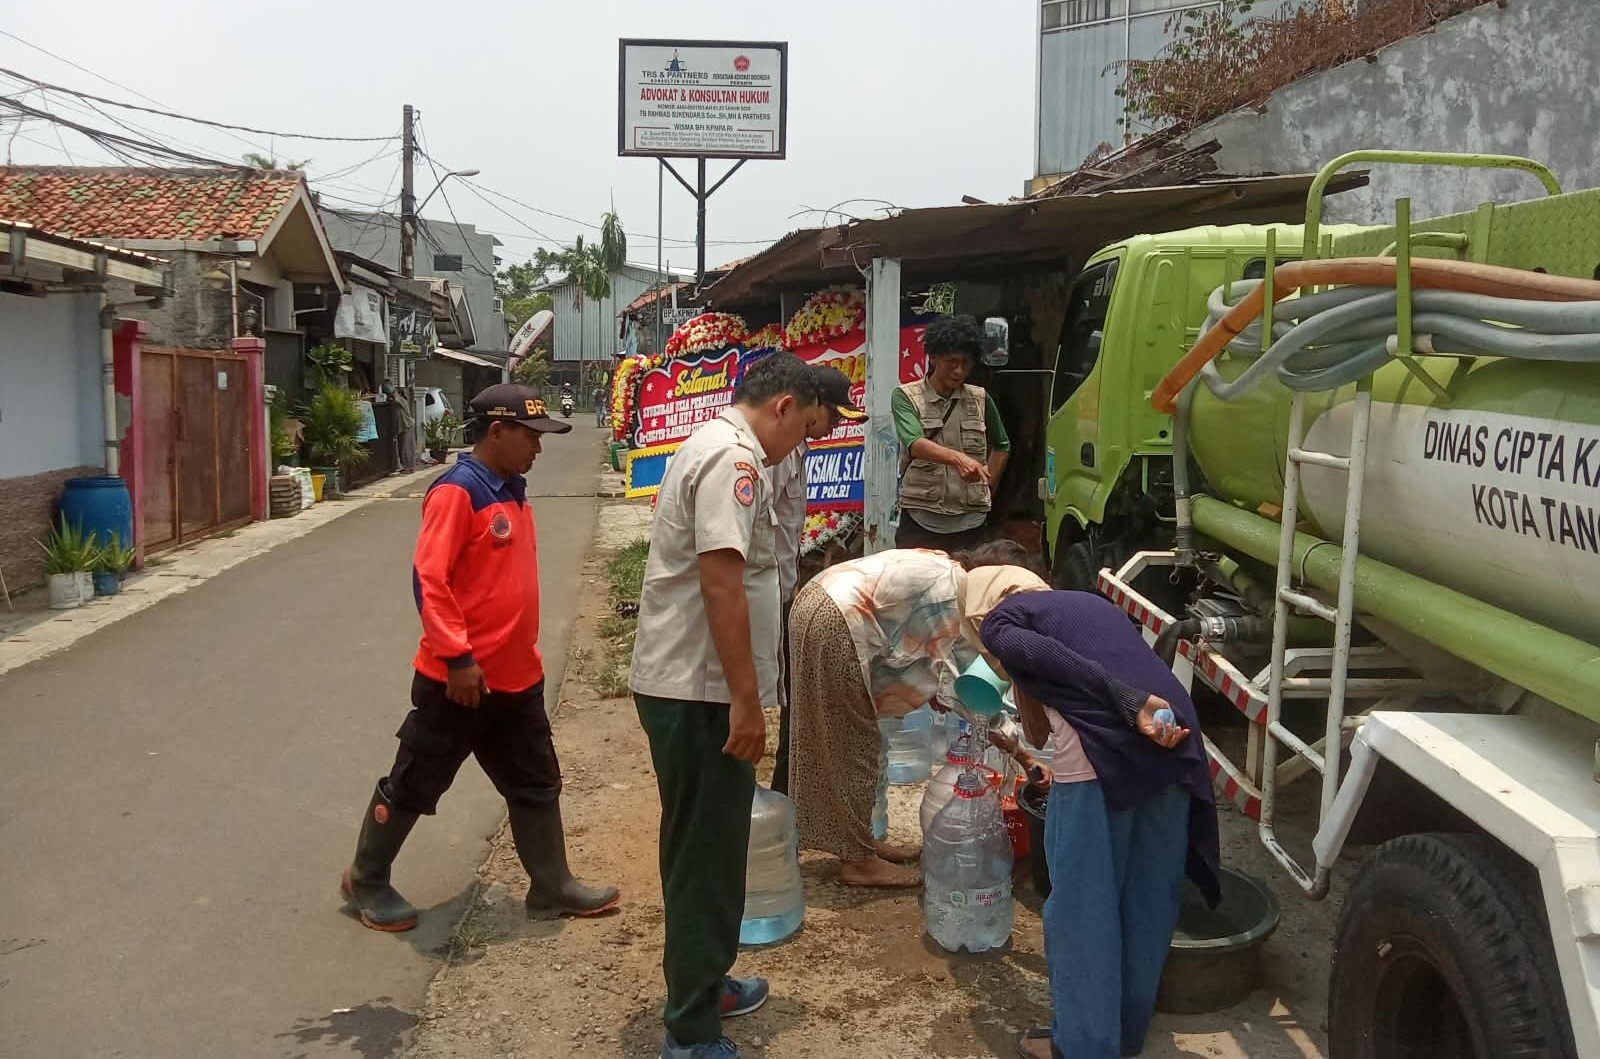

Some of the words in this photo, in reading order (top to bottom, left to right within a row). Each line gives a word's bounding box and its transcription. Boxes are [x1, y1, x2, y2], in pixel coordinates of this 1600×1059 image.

[642, 70, 657, 78] TRS
[667, 71, 709, 80] PARTNERS
[640, 88, 678, 101] ADVOKAT
[680, 89, 687, 102] &
[689, 89, 737, 103] KONSULTAN
[739, 90, 769, 104] HUKUM
[648, 110, 671, 118] RAHMAD
[743, 113, 771, 121] PARTNERS
[674, 123, 694, 131] WISMA
[674, 361, 729, 397] Selamat
[1424, 420, 1489, 468] DINAS
[1494, 427, 1565, 483] CIPTA
[820, 484, 850, 499] POLRI
[1472, 483, 1541, 538] KOTA
[1540, 497, 1600, 554] TAN
